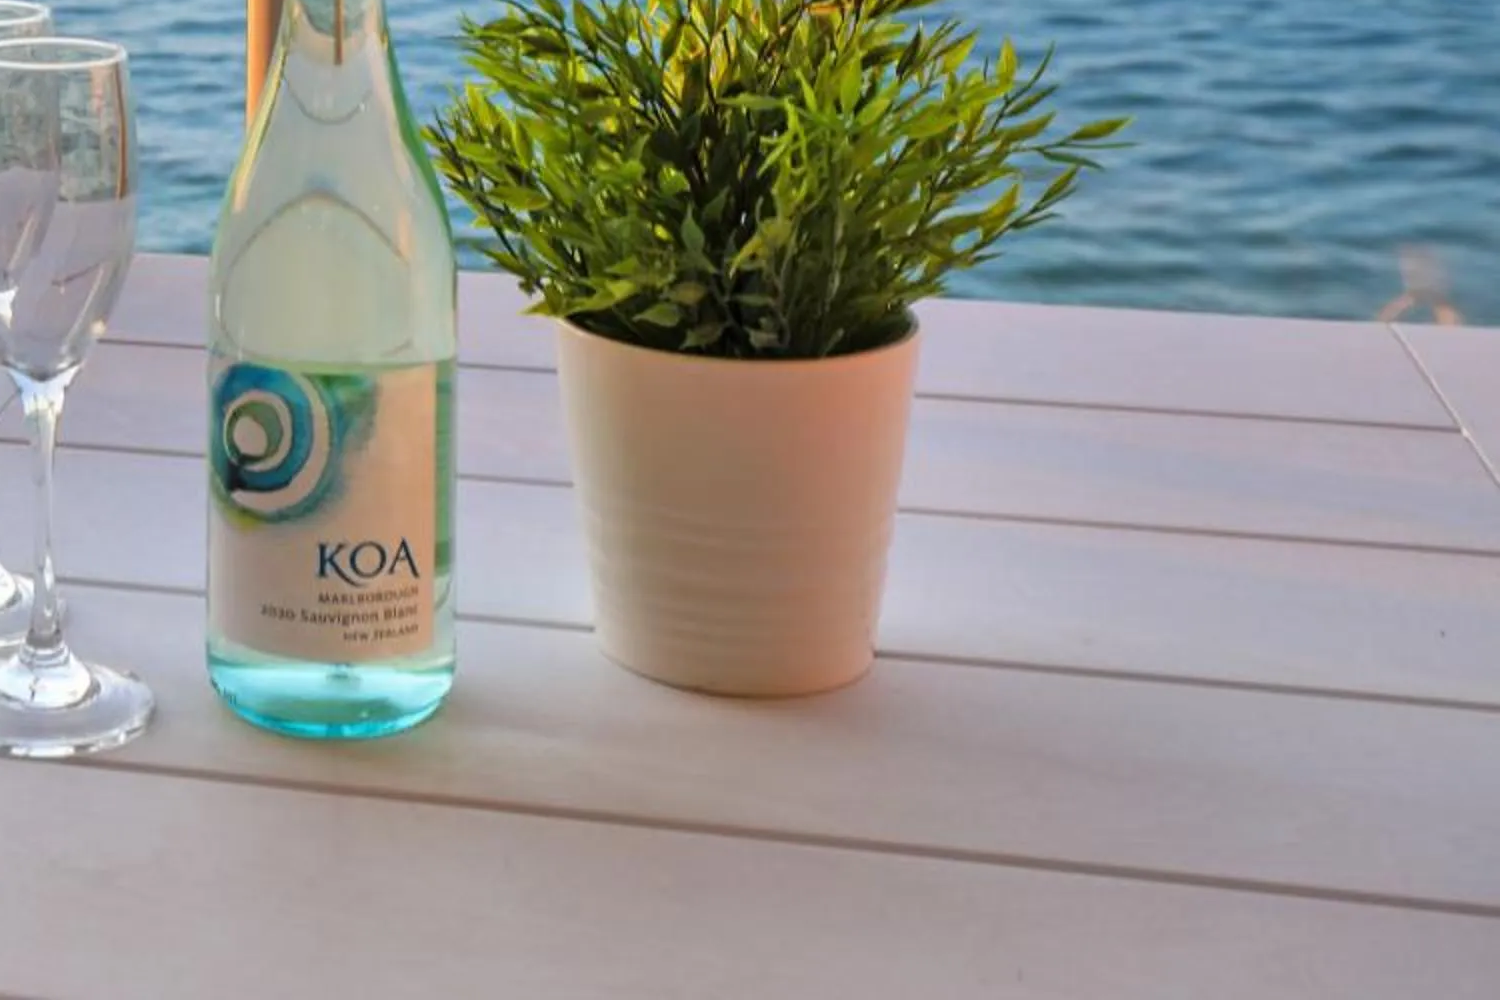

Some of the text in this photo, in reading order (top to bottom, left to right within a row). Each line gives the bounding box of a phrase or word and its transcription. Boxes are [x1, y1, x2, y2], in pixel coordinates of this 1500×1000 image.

[317, 536, 420, 587] KOA
[318, 585, 419, 604] MARLBOROUGH
[300, 607, 379, 626] Sauvignon
[384, 603, 418, 620] Blanc
[343, 623, 419, 641] NEW ZEALAND
